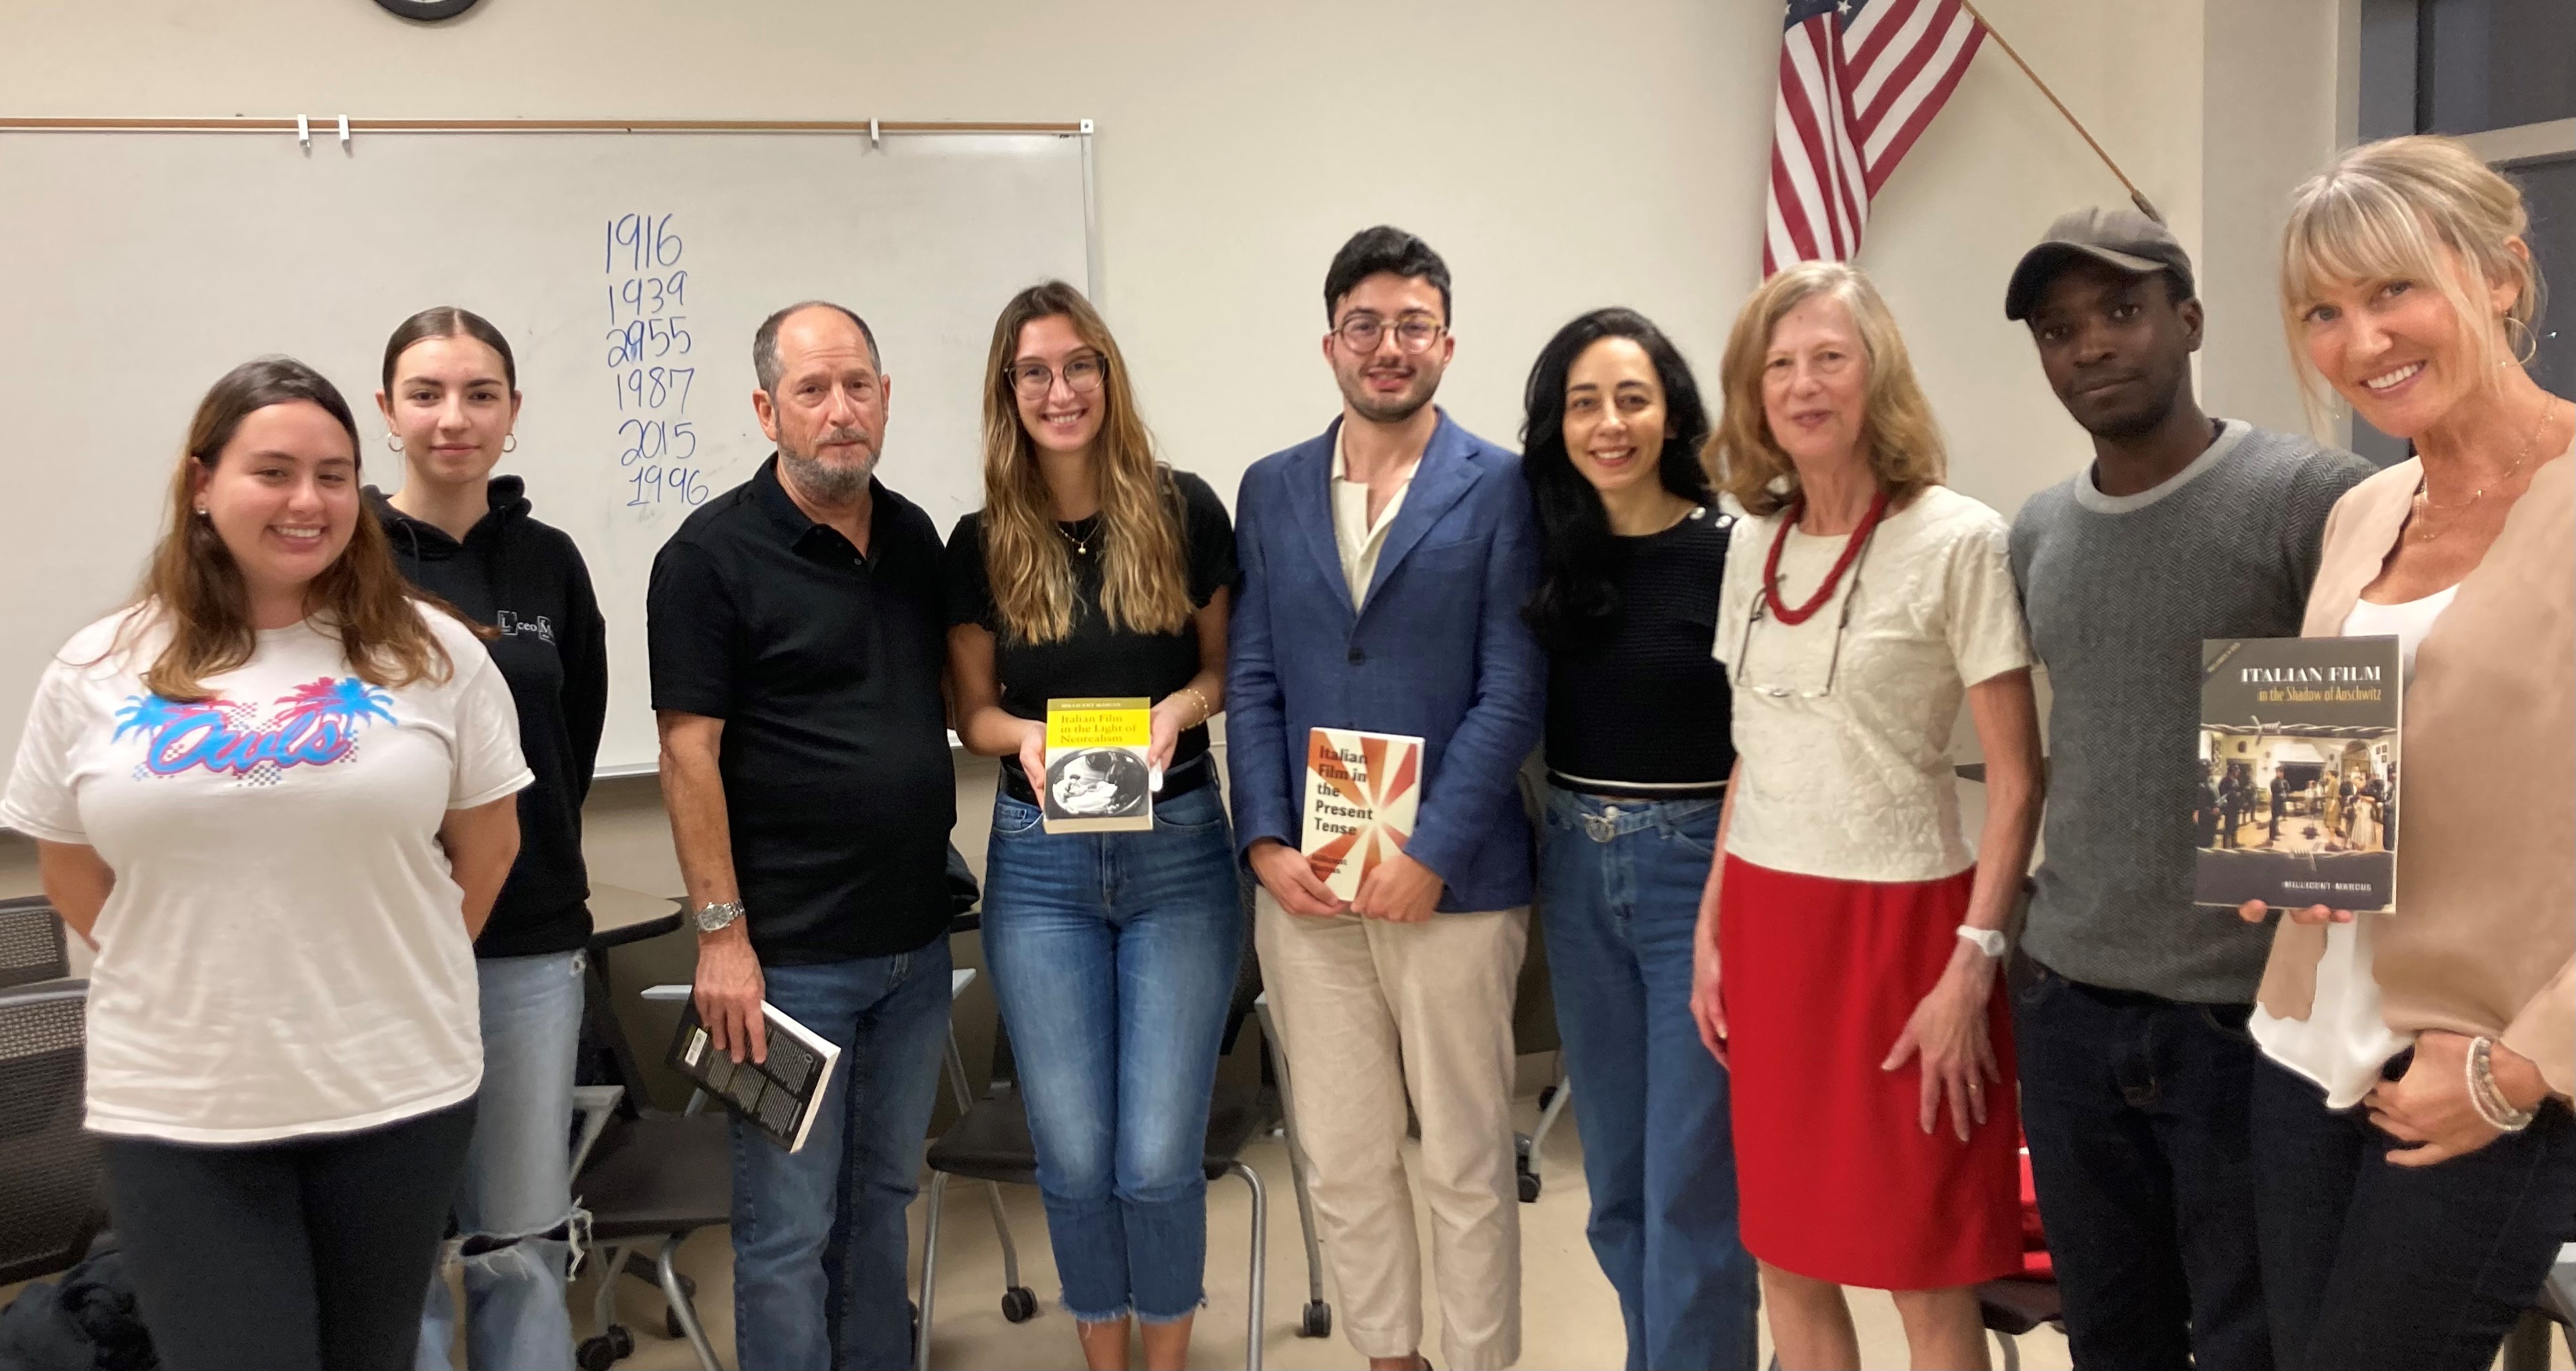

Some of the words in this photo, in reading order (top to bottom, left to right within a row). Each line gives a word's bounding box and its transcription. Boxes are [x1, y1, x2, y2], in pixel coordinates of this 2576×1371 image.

[606, 213, 682, 274] 1916
[609, 270, 688, 326] 1939
[617, 367, 695, 415] 1987
[618, 419, 696, 466] 2015
[627, 465, 709, 506] 1996
[2240, 667, 2324, 683] ITALIAN
[2328, 666, 2381, 681] FILM
[2258, 688, 2268, 702] in
[2270, 687, 2285, 701] the
[2286, 686, 2326, 702] Shadow
[2327, 686, 2335, 701] of
[2335, 686, 2382, 701] Auschwitz
[1061, 714, 1096, 723] Italian
[1060, 724, 1070, 733] in
[1074, 724, 1092, 733] the
[1094, 724, 1122, 734] Light
[1125, 723, 1138, 732] of
[1060, 735, 1123, 744] Neorealism
[1319, 745, 1368, 764] Italian
[1318, 764, 1349, 781] Film
[1351, 768, 1367, 783] in
[1317, 783, 1341, 797] the
[1316, 800, 1373, 820] Present
[1315, 818, 1357, 835] Tense
